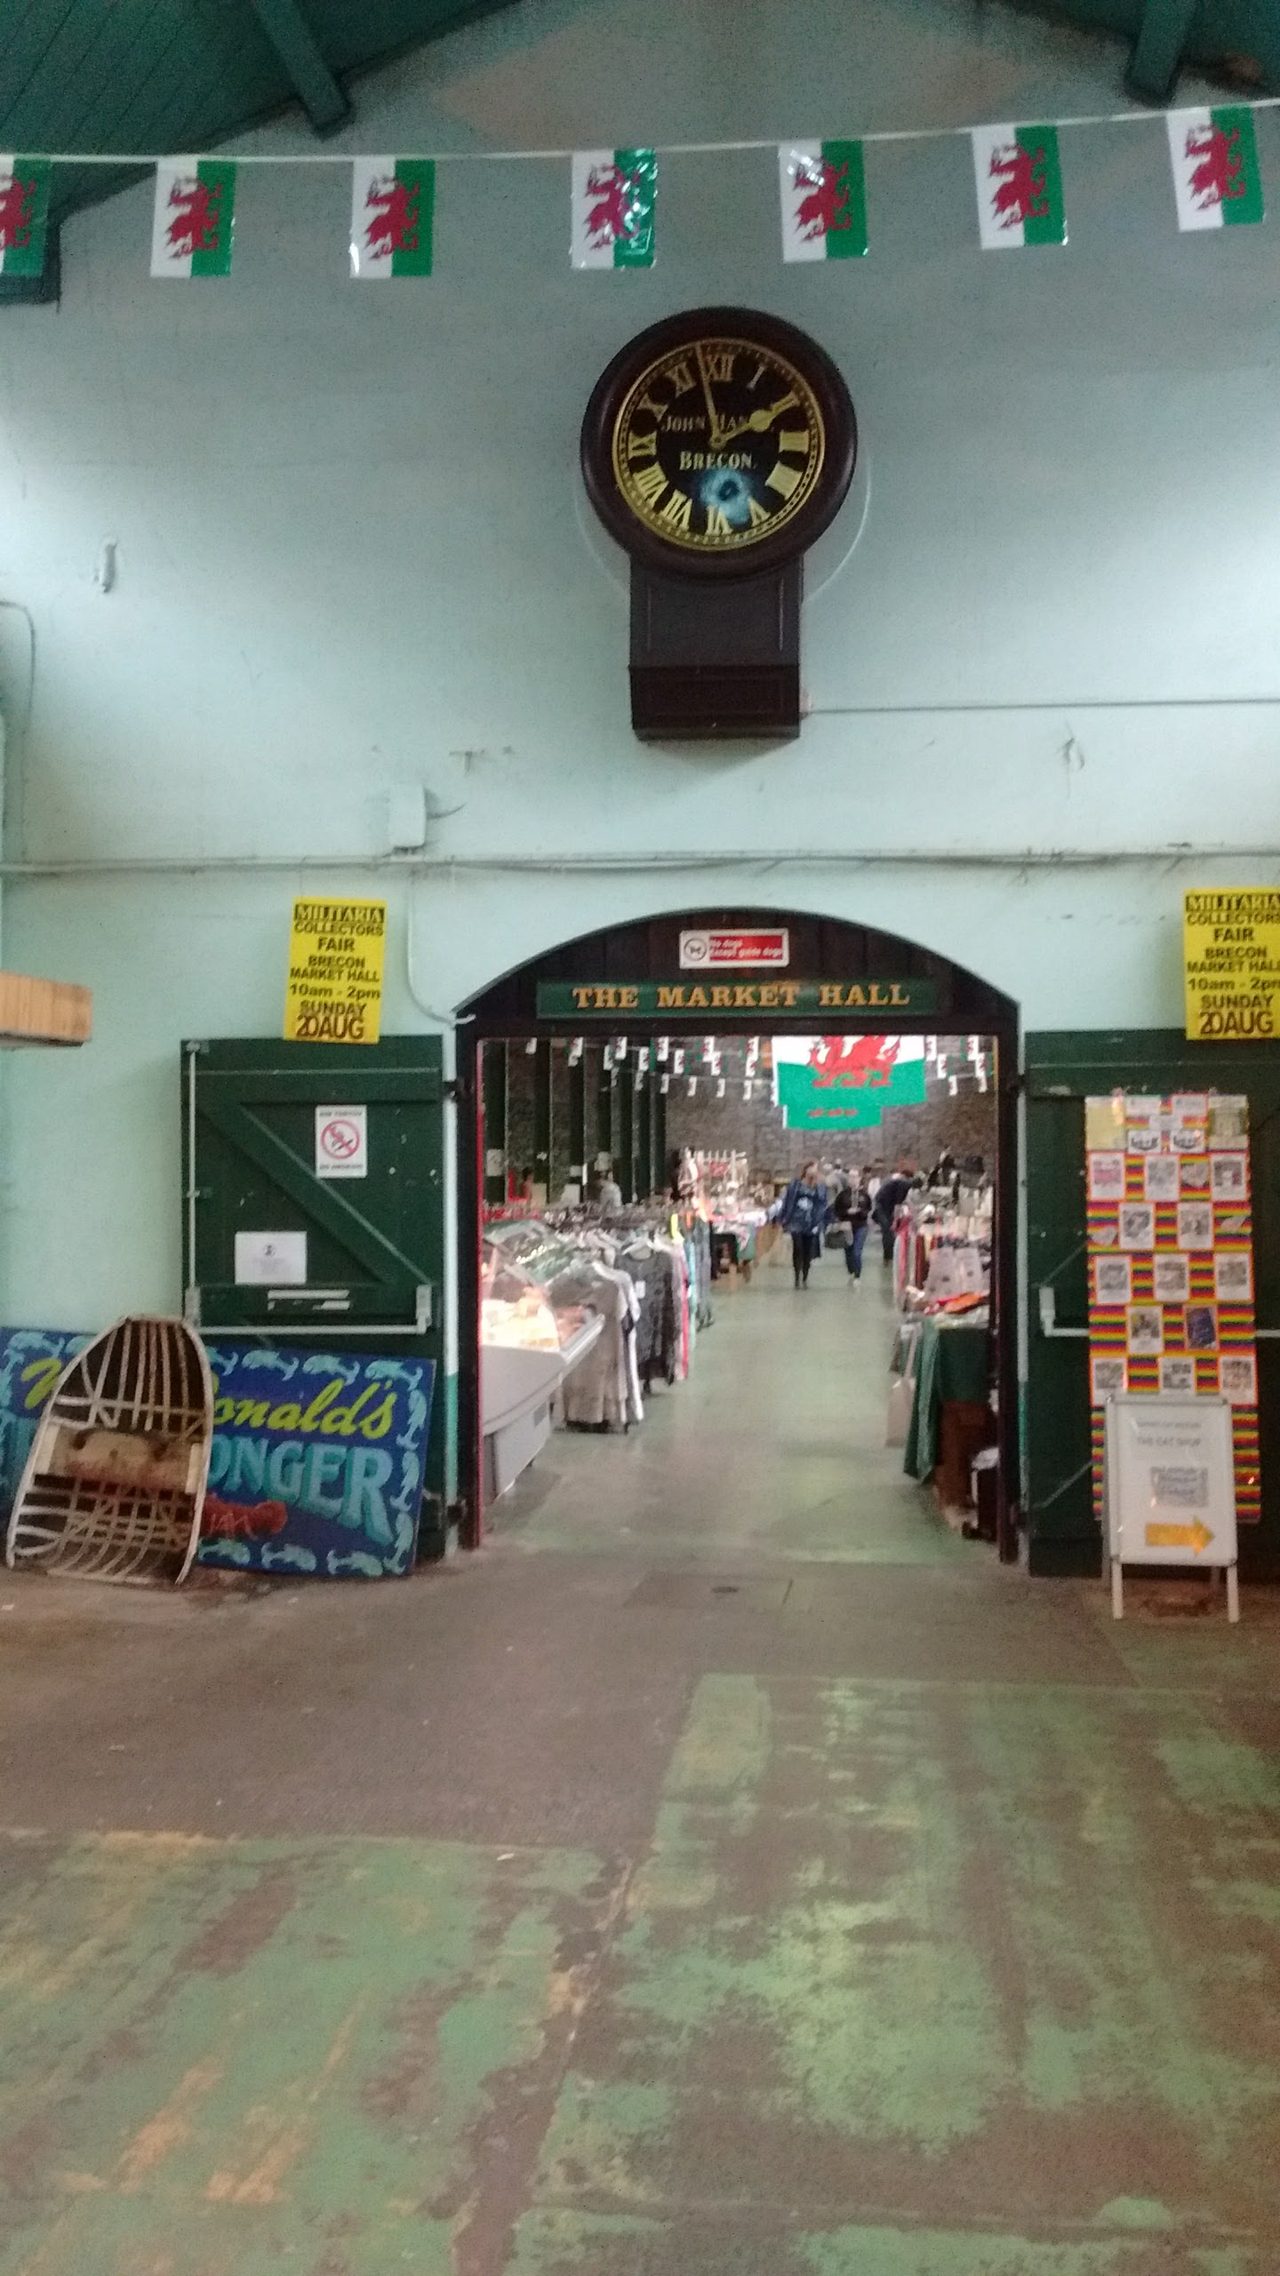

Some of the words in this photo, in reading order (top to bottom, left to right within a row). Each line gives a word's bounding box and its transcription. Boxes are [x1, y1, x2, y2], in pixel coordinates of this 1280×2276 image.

[661, 414, 706, 432] JOHN
[1186, 894, 1280, 912] MILITARIA
[293, 904, 385, 923] MILITARIA
[1187, 912, 1280, 925] COLLECTORS
[293, 921, 384, 936] COLLECTORS
[1214, 928, 1254, 942] FAIR
[317, 936, 355, 952] FAIR
[1205, 946, 1268, 960] BRECON
[307, 954, 366, 969] BRECON
[1187, 960, 1244, 974] MARKET
[289, 966, 343, 981] MARKET
[346, 969, 380, 983] HALL
[1188, 977, 1236, 990] 10am
[290, 983, 333, 998] 10am
[346, 985, 381, 1001] 2pm
[572, 986, 639, 1009] THE
[656, 983, 798, 1008] MARKET
[818, 983, 910, 1006] HALL
[299, 999, 367, 1016] SUNDAY
[1201, 994, 1274, 1009] SUNDAY
